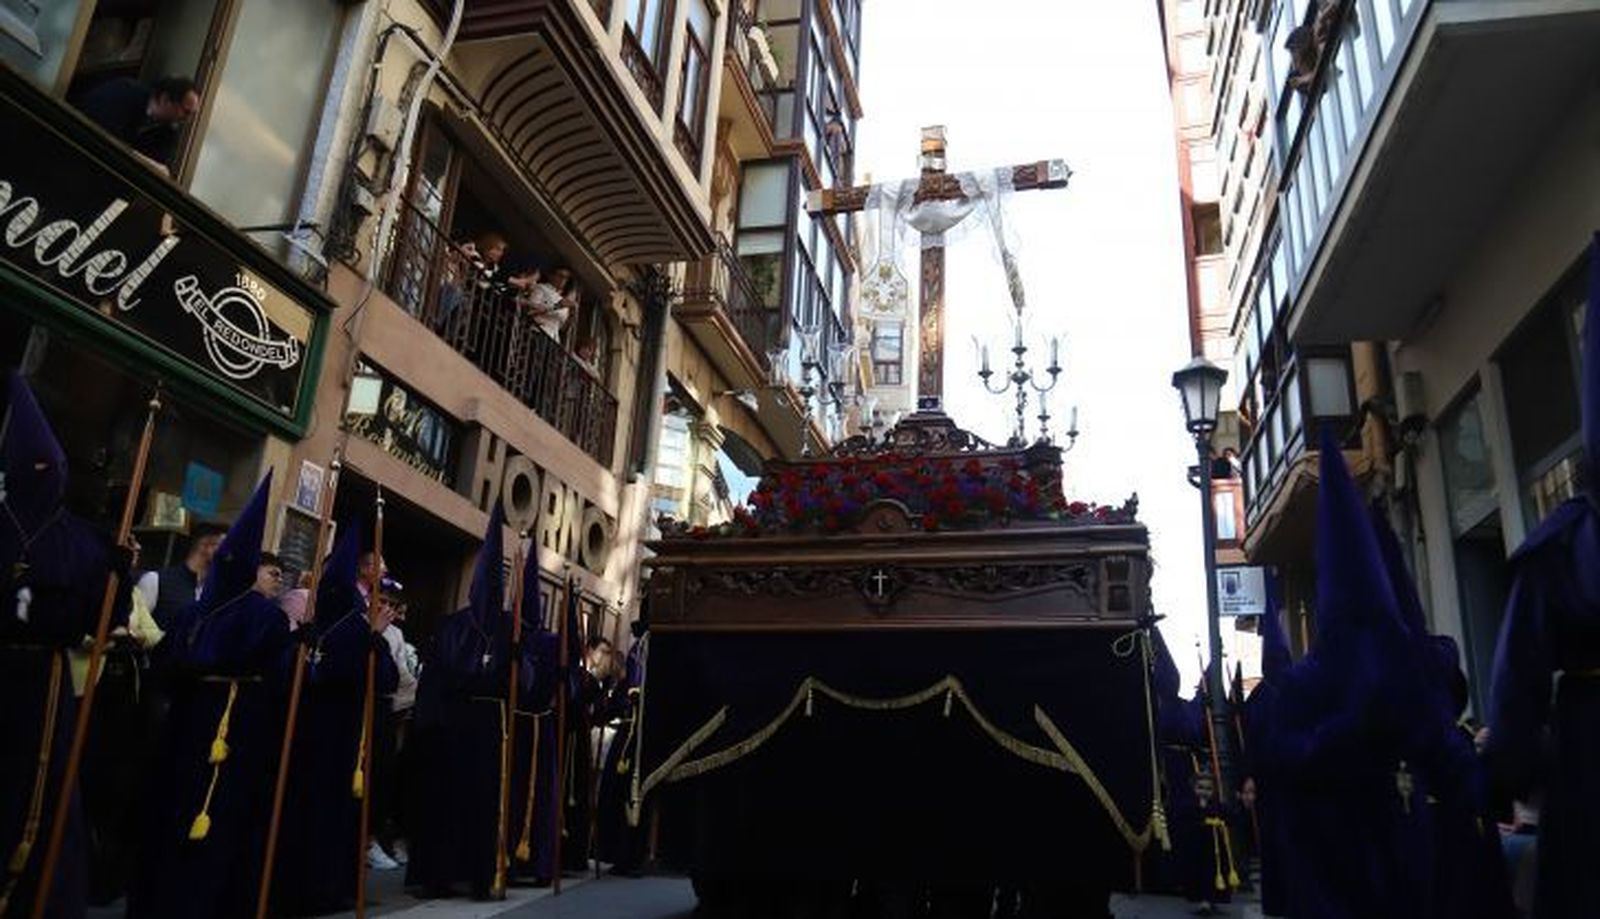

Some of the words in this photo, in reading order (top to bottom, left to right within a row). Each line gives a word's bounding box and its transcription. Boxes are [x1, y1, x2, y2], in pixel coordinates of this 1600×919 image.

[192, 298, 209, 321] EL
[212, 319, 284, 360] REDONDEL
[471, 425, 614, 577] HORNO
